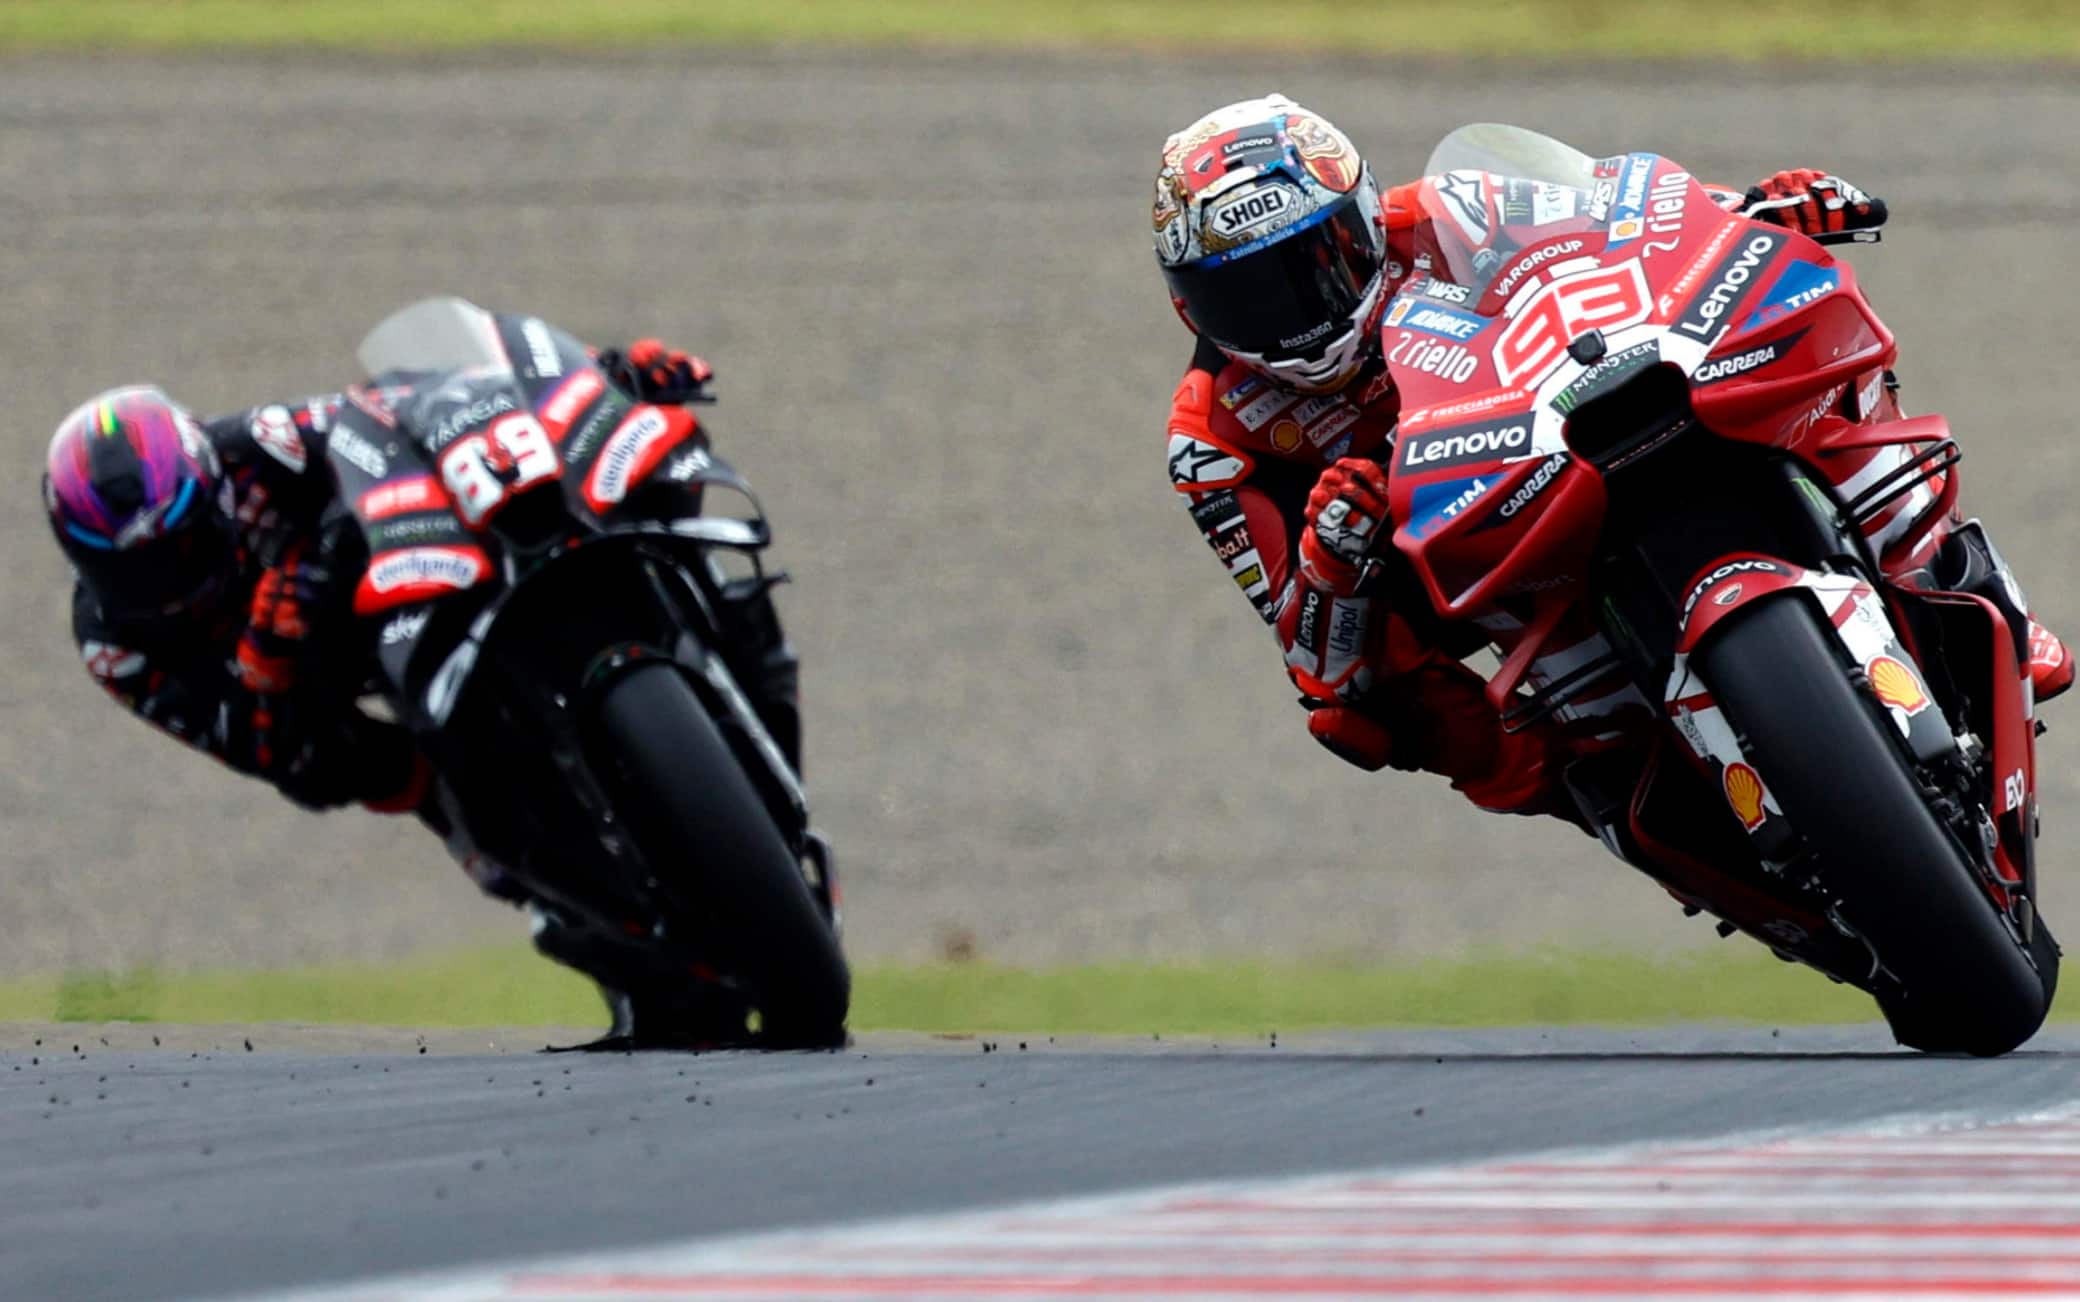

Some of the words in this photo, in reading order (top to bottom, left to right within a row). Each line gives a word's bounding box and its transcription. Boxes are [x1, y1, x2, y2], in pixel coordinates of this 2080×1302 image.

[1224, 137, 1273, 154] Lenovo
[1589, 181, 1615, 221] WRS
[1619, 157, 1653, 212] ADVANCE
[1651, 171, 1692, 233] riello
[1219, 190, 1284, 231] SHOEI
[1495, 239, 1584, 297] VARGROUP
[1680, 235, 1773, 336] Lenovo
[1426, 278, 1470, 303] WRS
[1785, 281, 1835, 308] TIM
[1279, 320, 1334, 349] Insta360
[1406, 309, 1480, 338] ADVANCE
[1494, 258, 1651, 388] 93
[1412, 338, 1479, 384] riello
[1695, 346, 1776, 382] CARRERA
[1431, 389, 1525, 418] FRECCIAROSSA
[1405, 426, 1527, 467] Lenovo
[1443, 478, 1489, 517] TIM
[1499, 454, 1568, 518] CARRERA
[1679, 560, 1778, 632] Lenovo
[1299, 591, 1320, 649] Lenovo
[1329, 601, 1366, 652] Unipol
